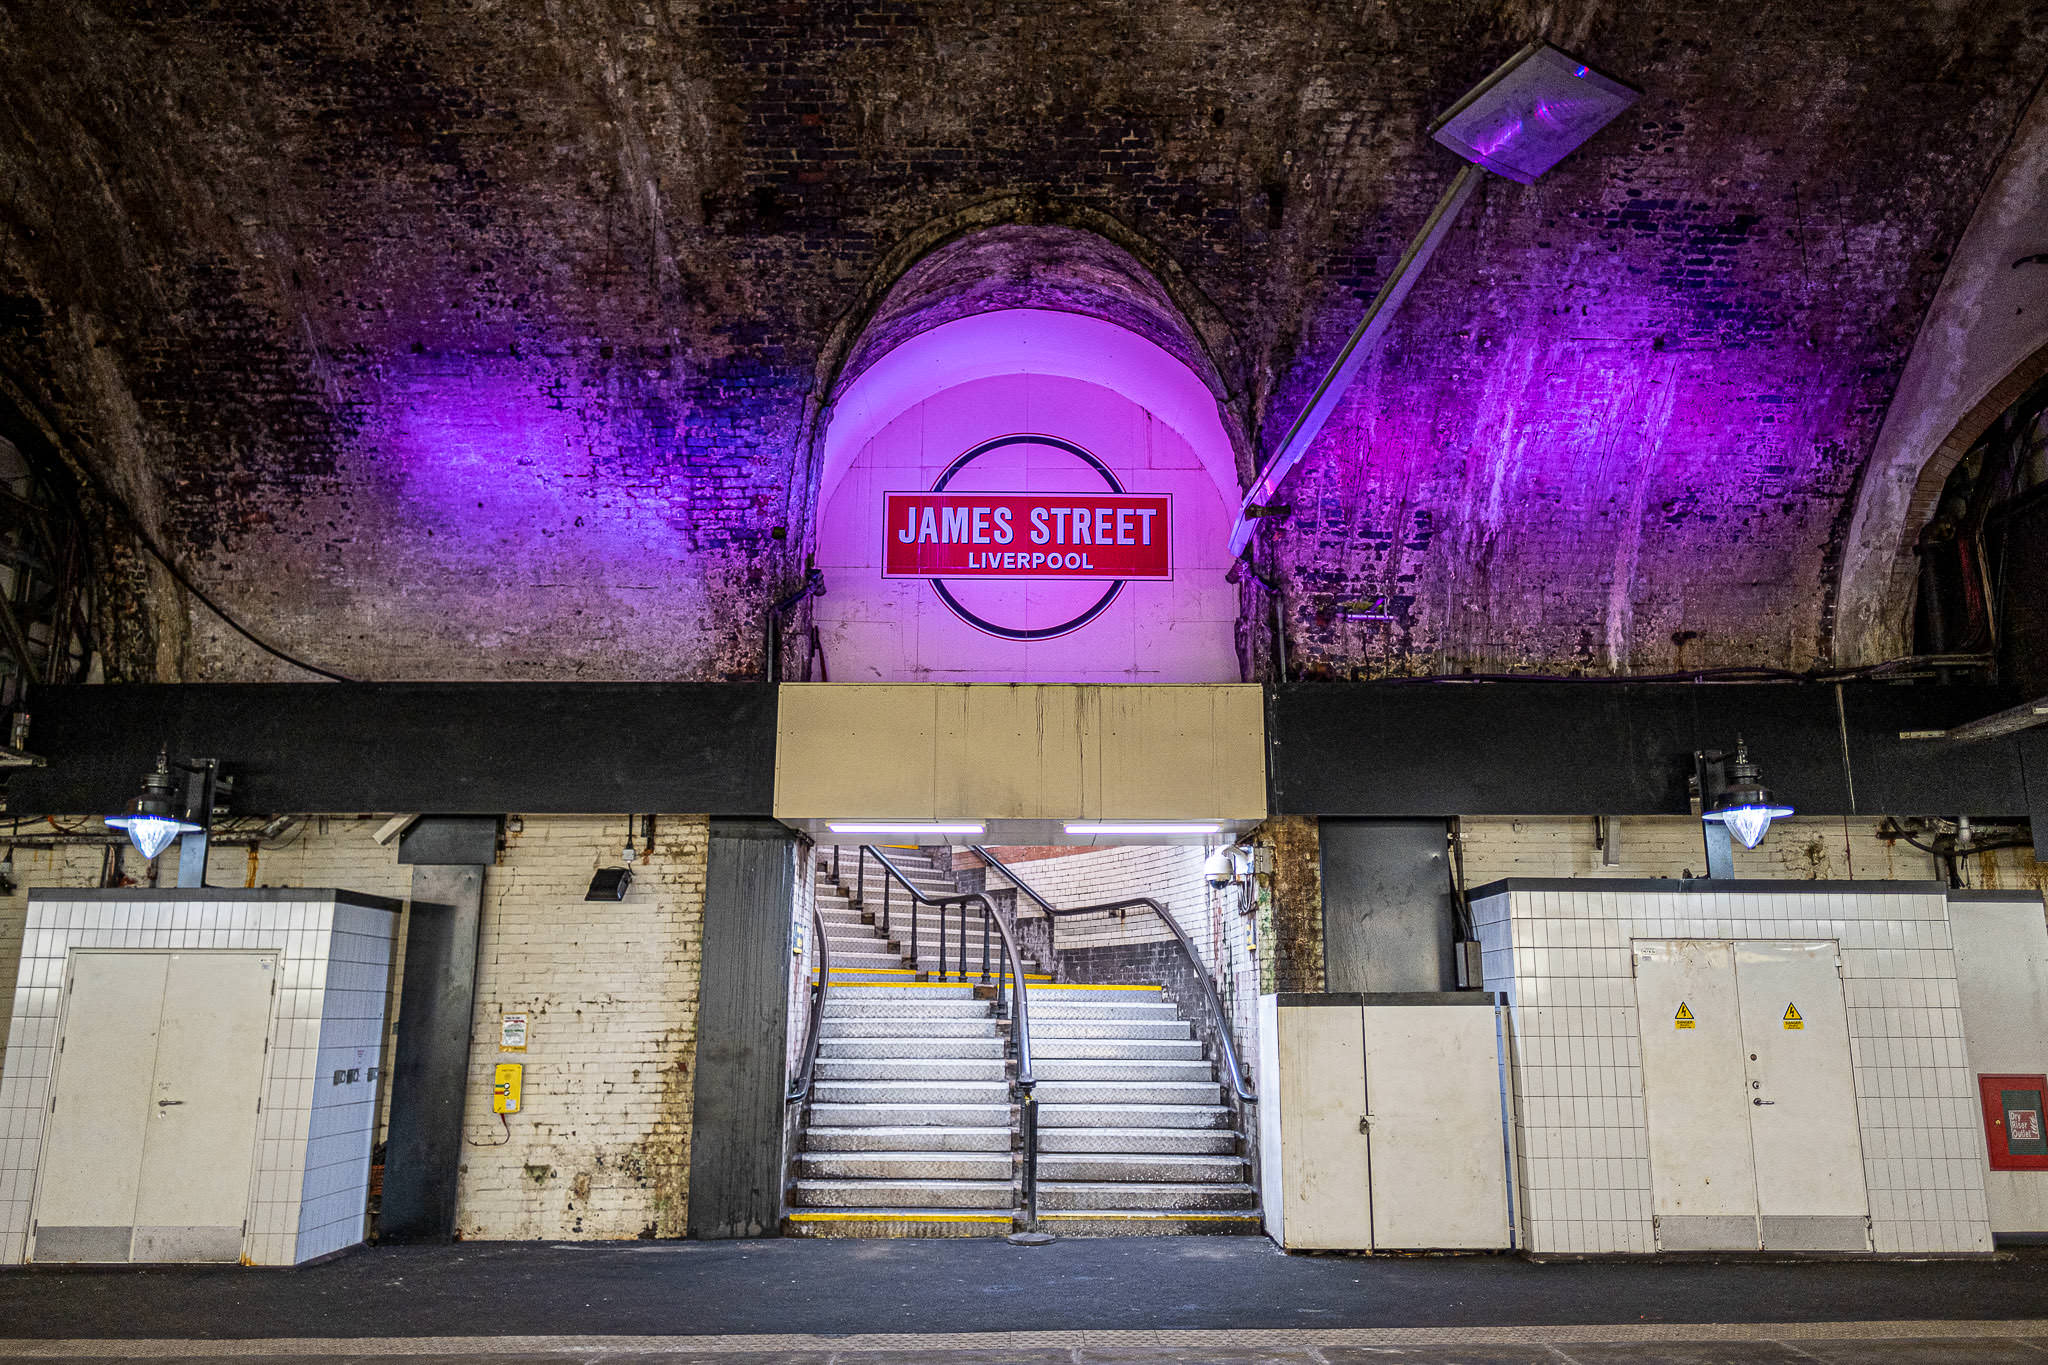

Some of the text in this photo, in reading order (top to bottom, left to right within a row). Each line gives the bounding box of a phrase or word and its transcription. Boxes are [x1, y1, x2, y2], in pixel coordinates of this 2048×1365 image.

[898, 506, 1157, 546] JAMES STREET
[968, 552, 1094, 570] LIVERPOOL
[2010, 1112, 2021, 1121] Dry
[2012, 1129, 2031, 1138] Outlet
